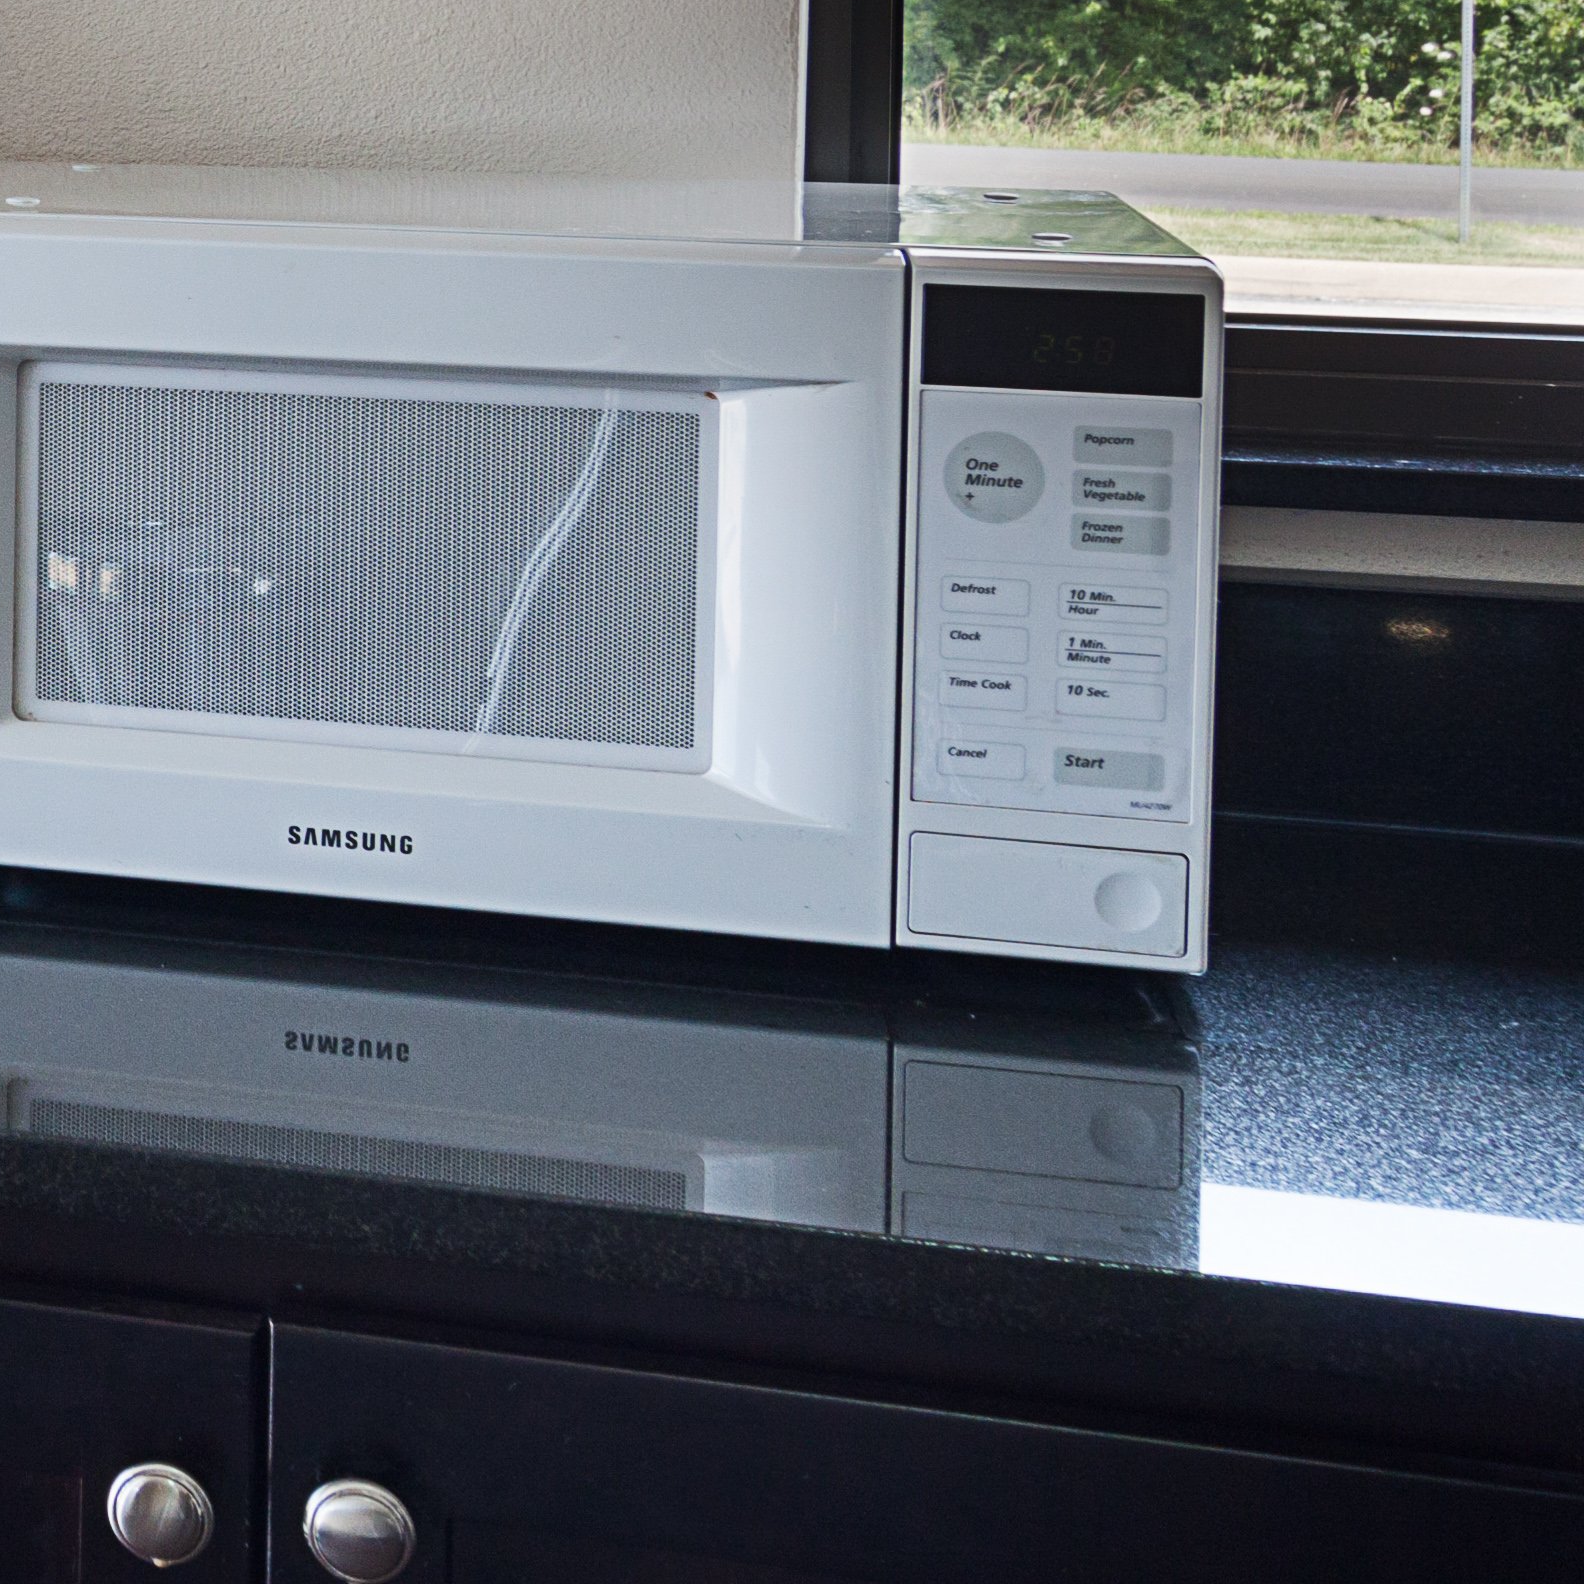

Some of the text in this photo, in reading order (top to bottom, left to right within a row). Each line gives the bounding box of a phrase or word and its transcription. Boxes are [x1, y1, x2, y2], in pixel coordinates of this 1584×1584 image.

[1084, 433, 1135, 446] Popcorn
[965, 458, 999, 472] One
[965, 473, 1023, 489] Minute
[1083, 477, 1116, 488] Fresh
[1083, 489, 1146, 502] Vegetable
[1082, 521, 1123, 532] Frozen
[1081, 533, 1124, 544] Dinner
[951, 583, 997, 595] Defrost
[1069, 589, 1116, 602] 10 Min.
[1068, 605, 1099, 616] Hour
[949, 630, 981, 641] Clock
[1068, 637, 1106, 650] 1 Min.
[1067, 652, 1111, 664] Minute
[949, 677, 1012, 690] Time Cook
[1067, 685, 1110, 698] 10 Sec.
[947, 746, 988, 759] Cancel
[1064, 754, 1105, 769] Start
[287, 825, 413, 855] SAMSUNG
